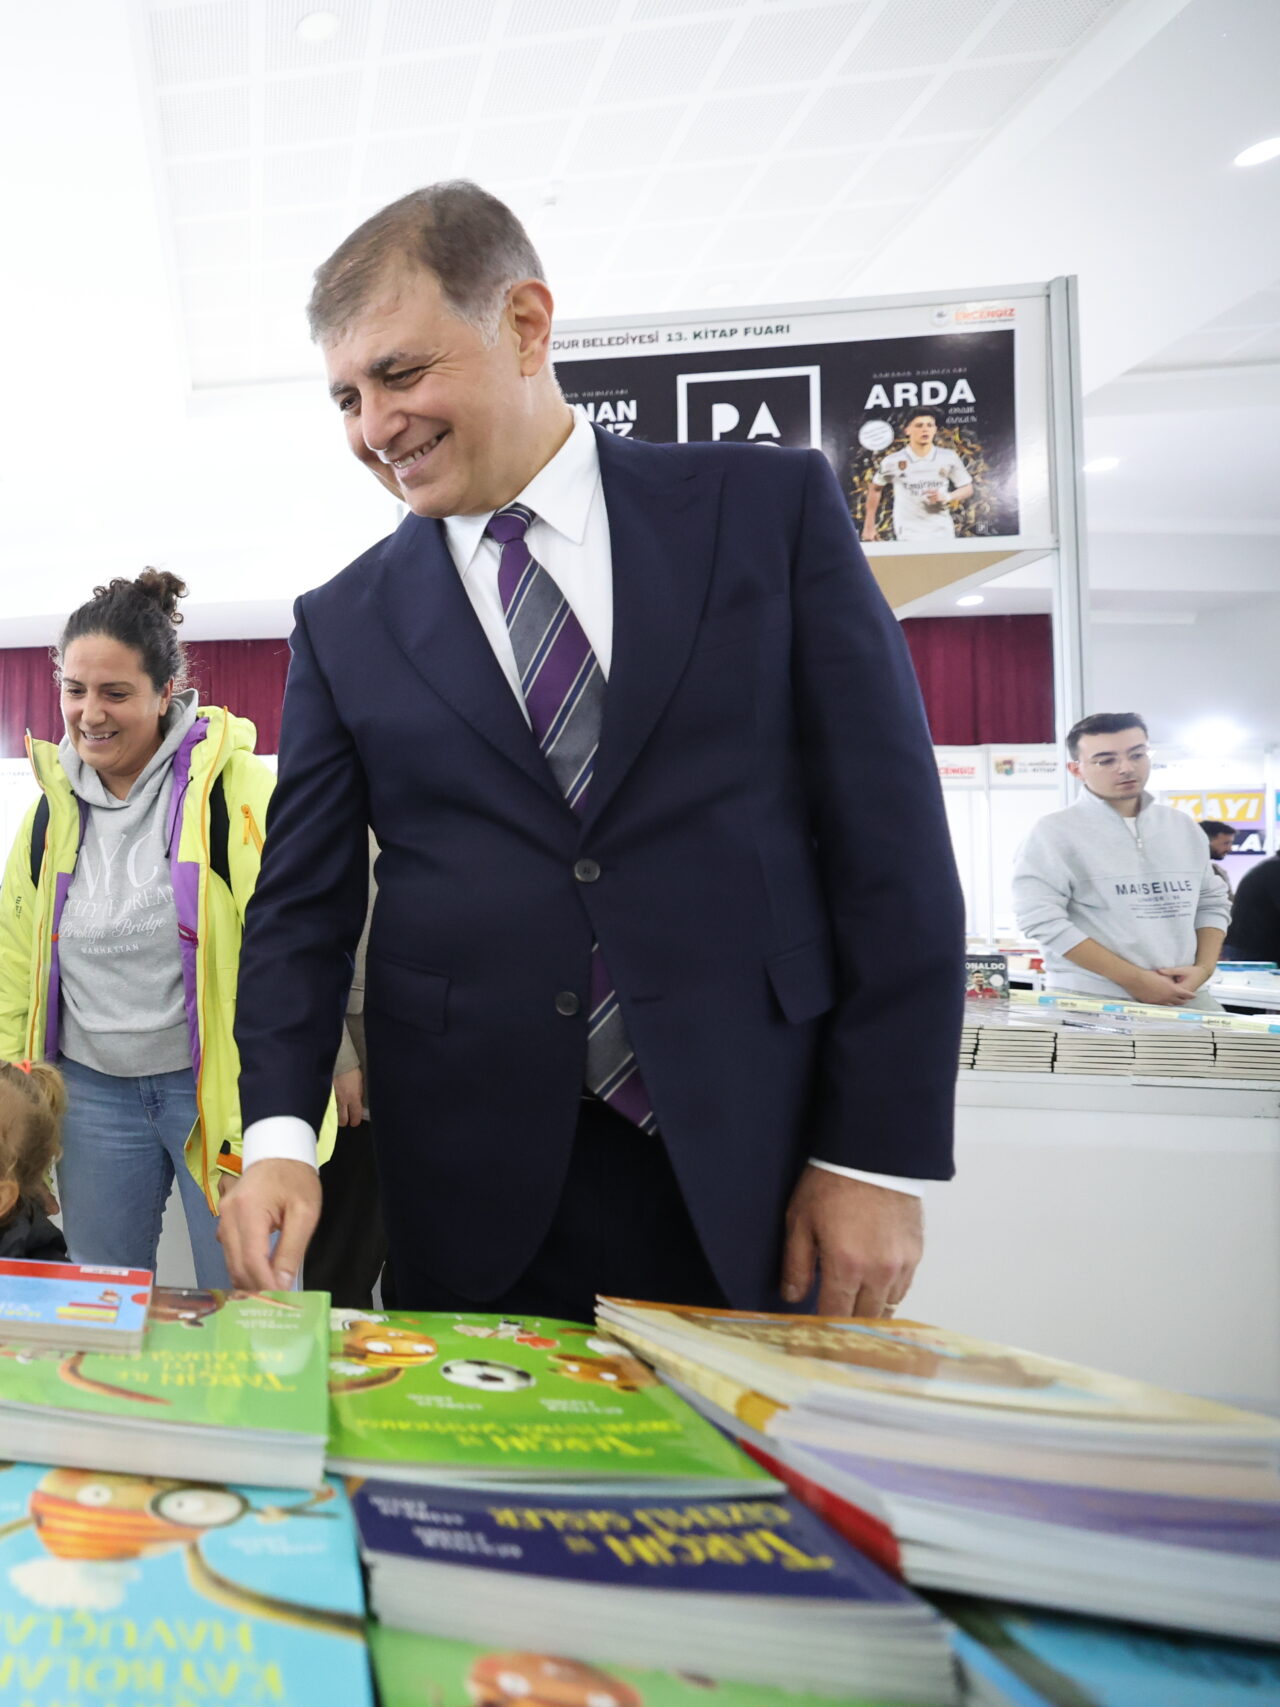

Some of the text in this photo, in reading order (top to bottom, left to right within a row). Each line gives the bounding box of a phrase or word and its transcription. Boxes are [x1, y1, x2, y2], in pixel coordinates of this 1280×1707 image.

[582, 330, 659, 349] BELEDİYESİ
[666, 331, 687, 343] 13.
[693, 326, 738, 340] KİTAP
[744, 323, 791, 338] FUARI
[863, 378, 977, 410] ARDA
[570, 399, 637, 423] NAN
[1115, 880, 1193, 896] MASEILLE
[61, 913, 168, 944] Brooklyn Bridge
[81, 943, 140, 955] MANHATTAN
